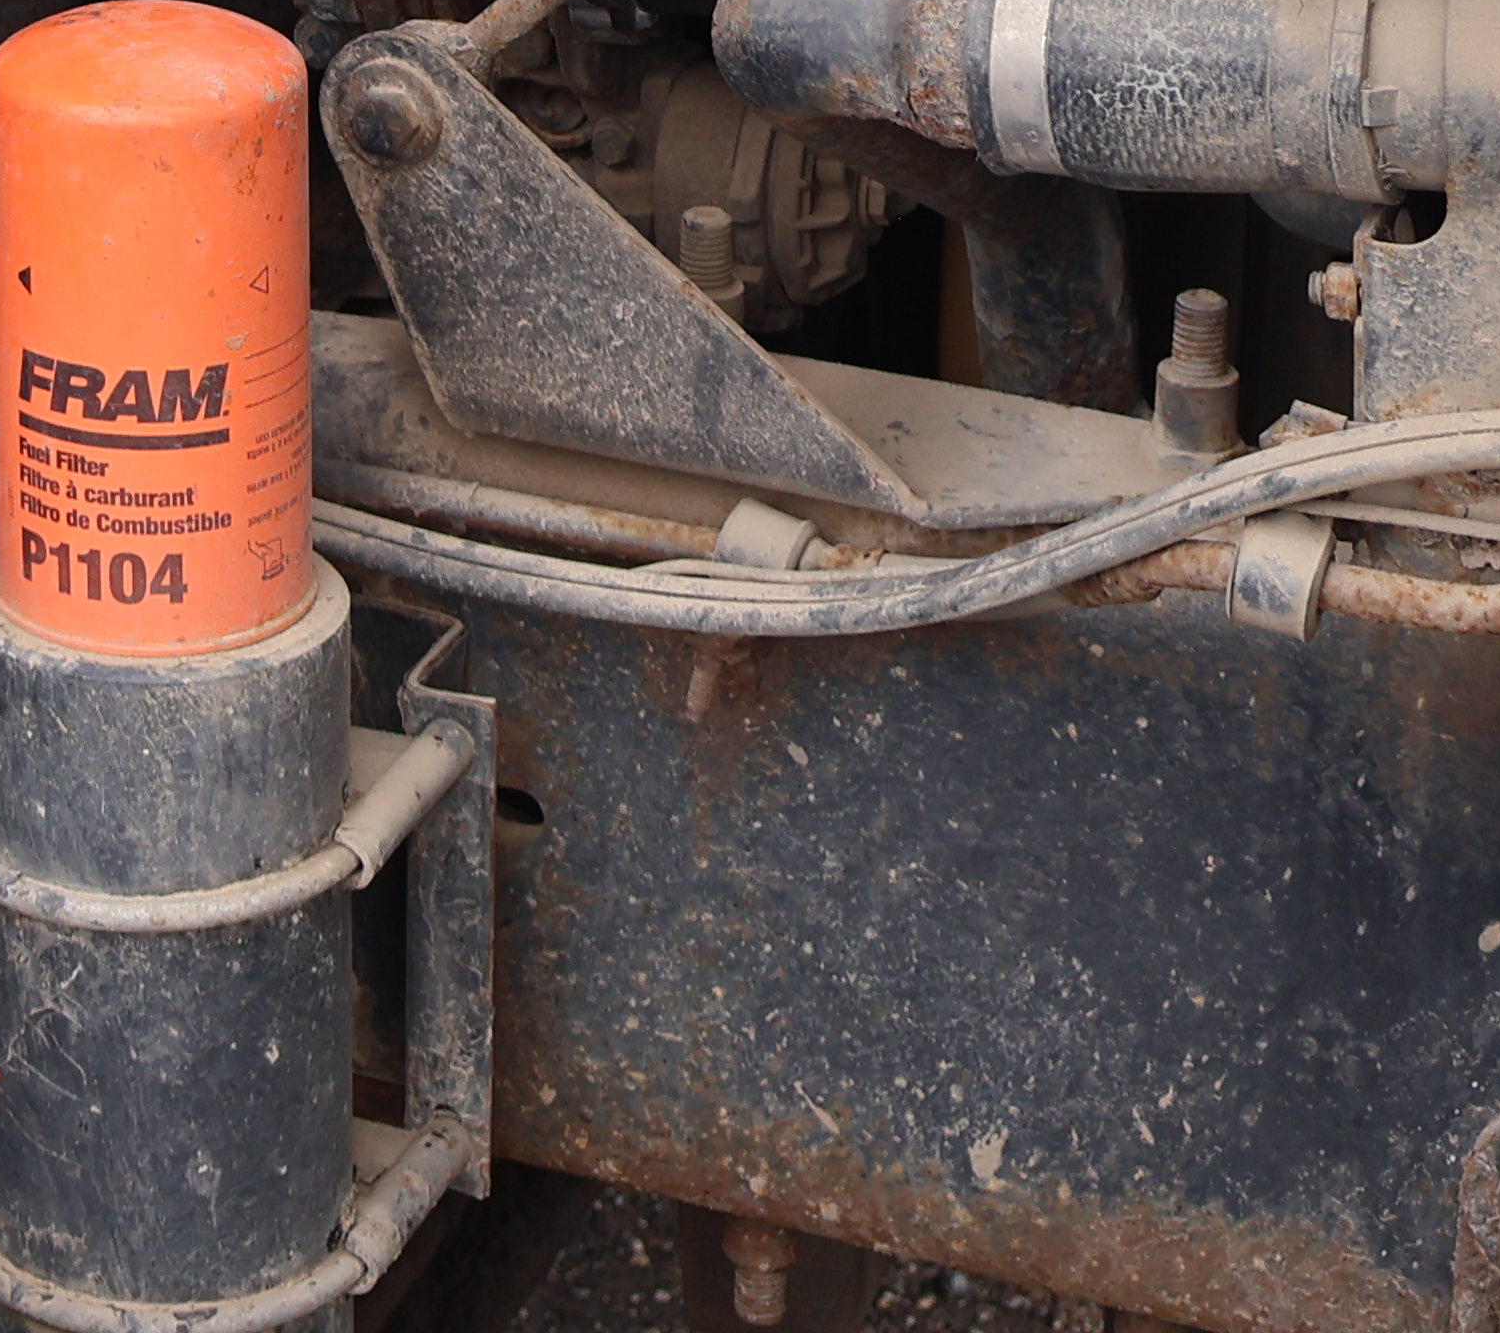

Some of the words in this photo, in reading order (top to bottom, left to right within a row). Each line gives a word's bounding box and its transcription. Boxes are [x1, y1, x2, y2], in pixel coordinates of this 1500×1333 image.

[18, 348, 229, 423] FRAM
[18, 435, 50, 465] Fuel
[56, 444, 109, 477] Filter
[18, 463, 59, 496] Filtre
[66, 479, 78, 500] à
[84, 486, 195, 508] carburant
[18, 491, 61, 524] Filtro
[66, 508, 90, 529] de
[96, 511, 232, 535] Combustible
[20, 526, 188, 605] P1104
